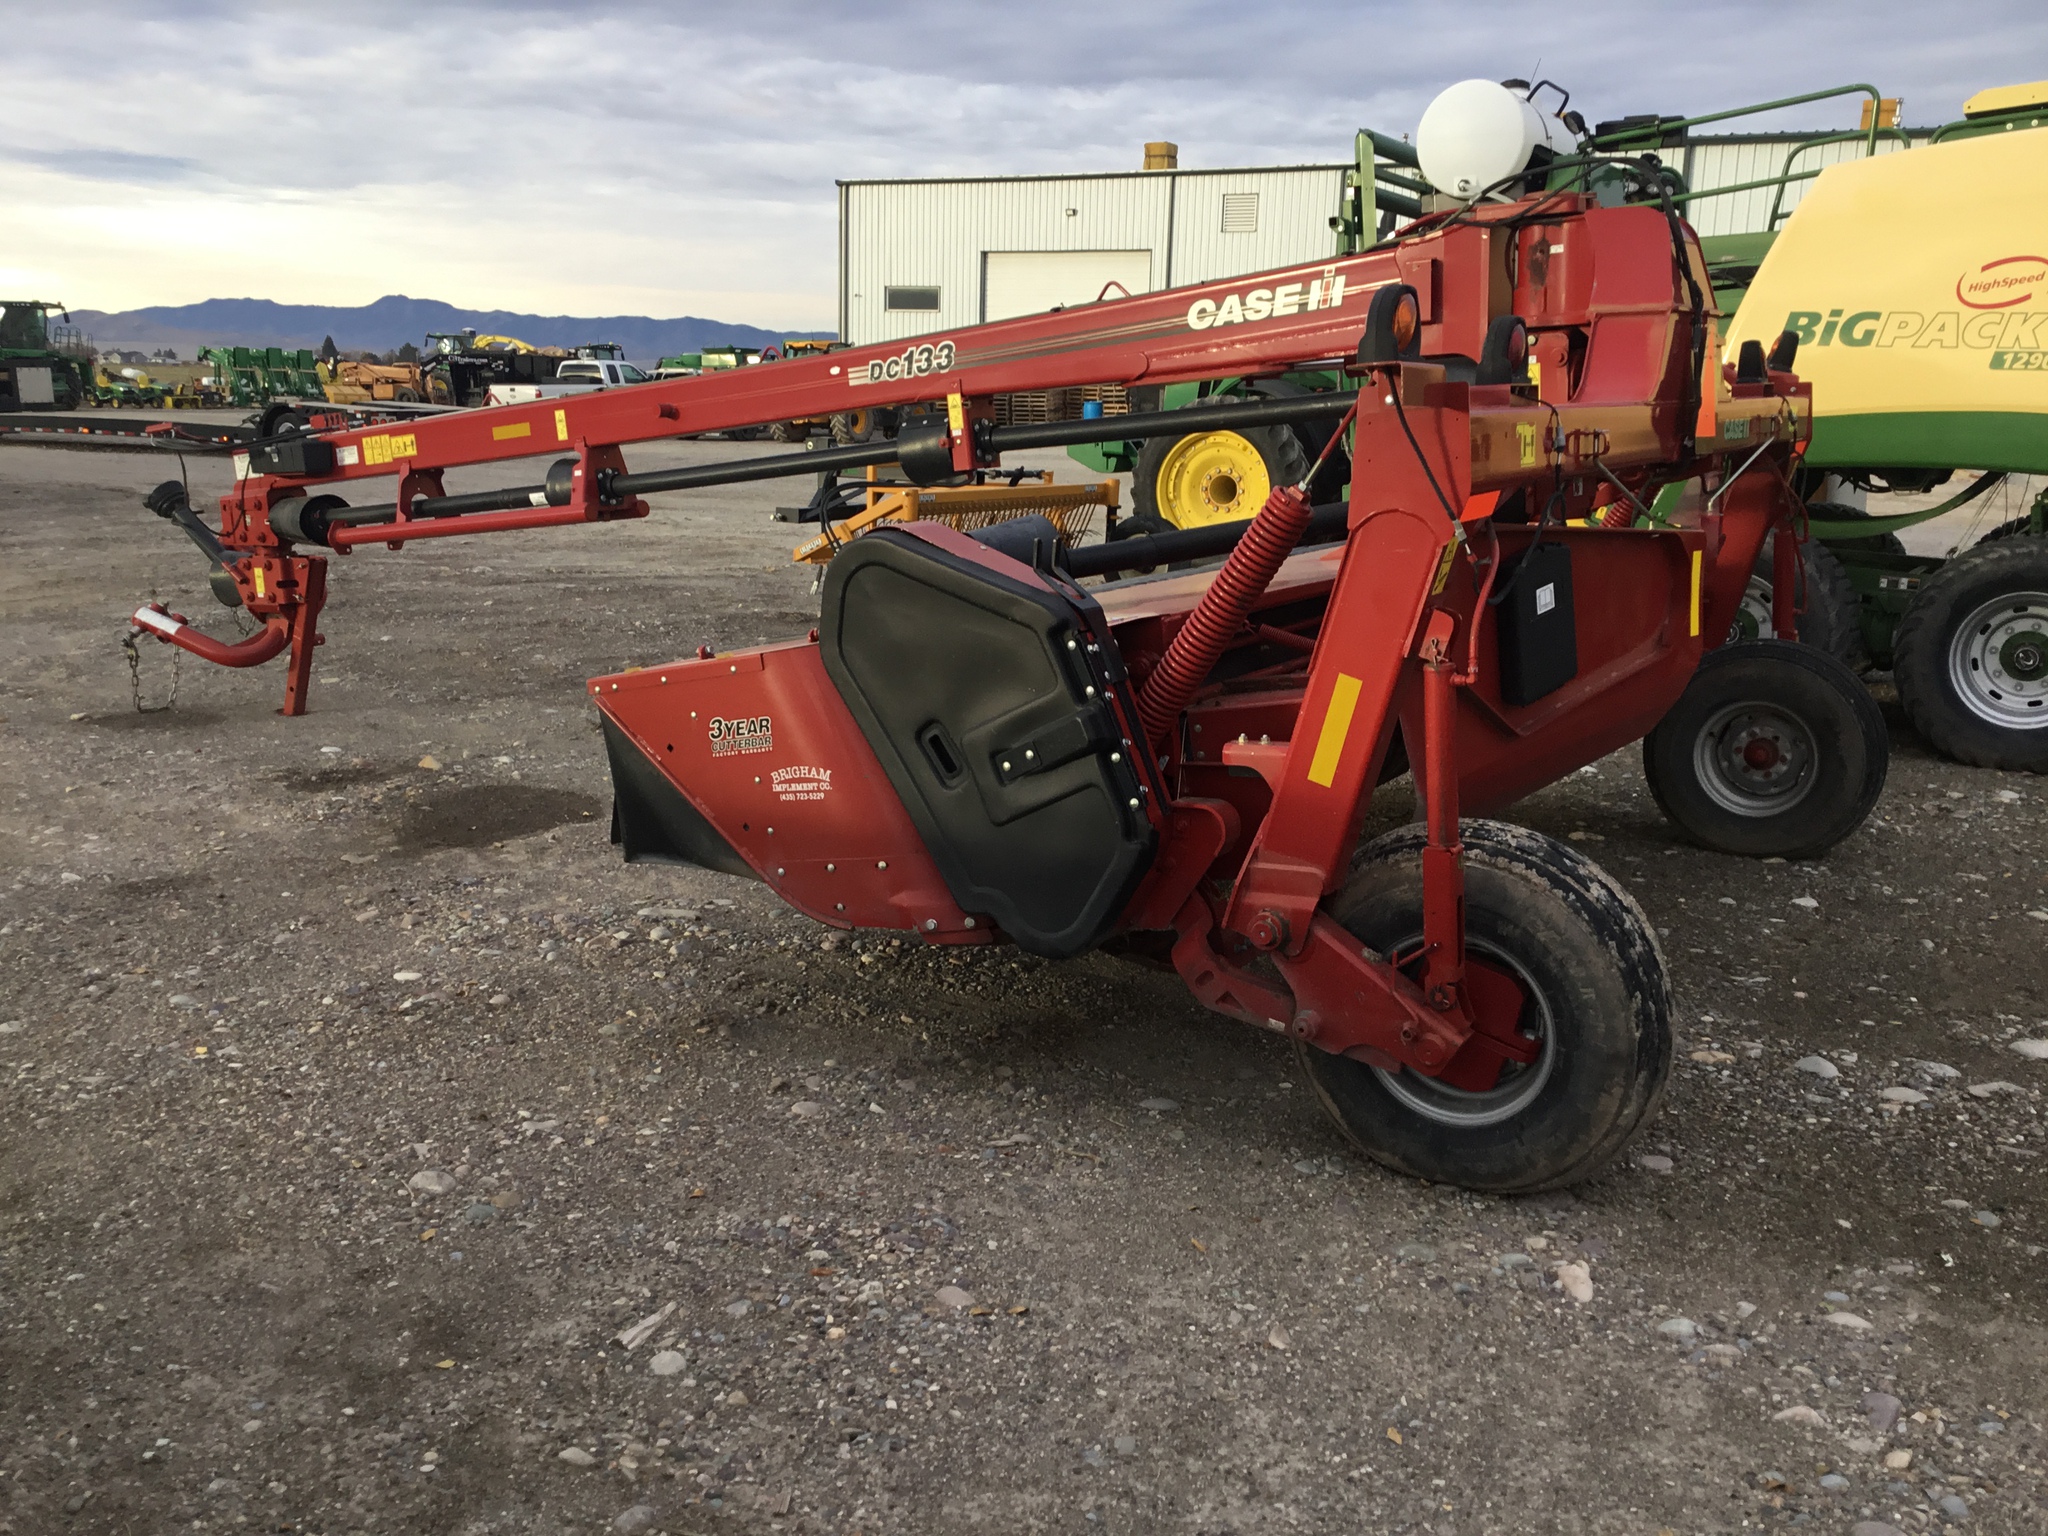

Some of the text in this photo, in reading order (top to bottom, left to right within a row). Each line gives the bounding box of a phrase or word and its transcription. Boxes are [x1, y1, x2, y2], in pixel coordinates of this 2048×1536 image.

[1967, 270, 2047, 294] HighSpeed
[1187, 283, 1302, 330] CASE
[868, 341, 956, 381] DC133
[711, 734, 773, 752] CUTTERBAR
[770, 765, 832, 784] BRIGHAM
[772, 782, 818, 792] IMPLEMENT
